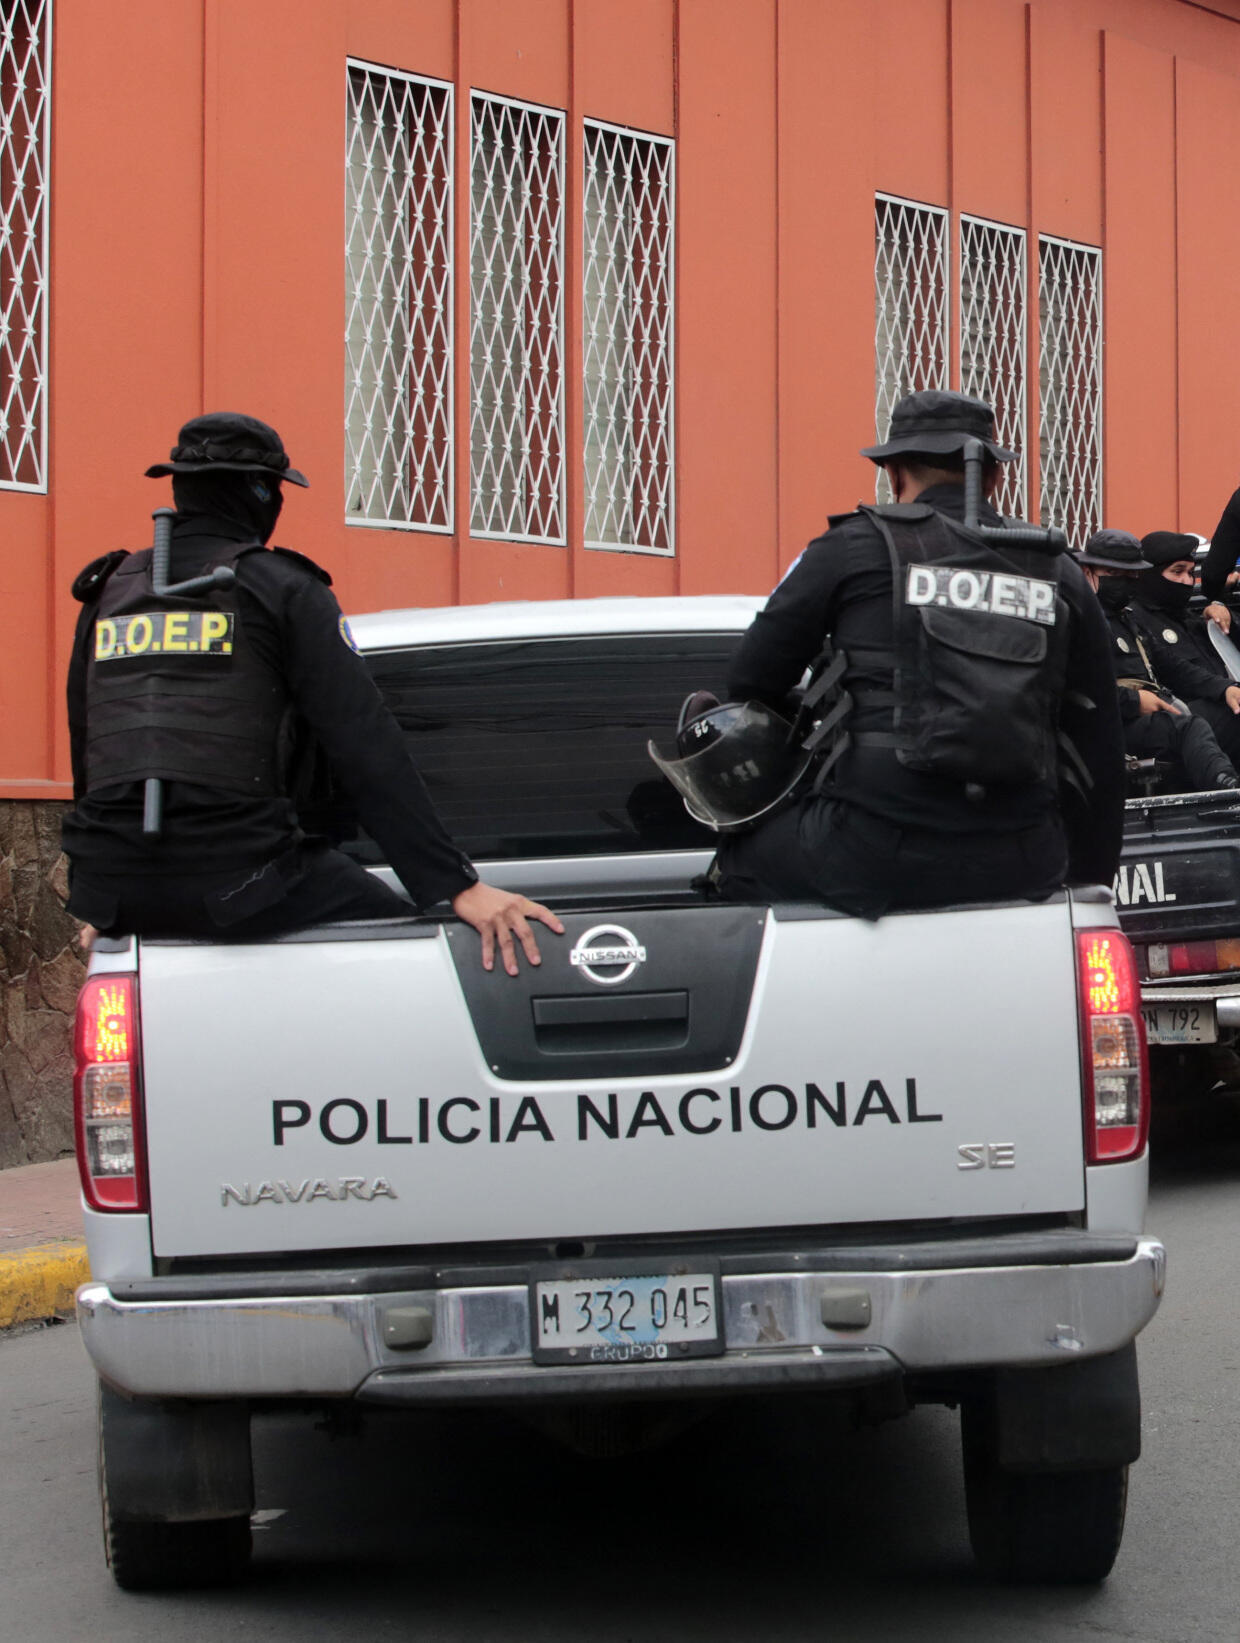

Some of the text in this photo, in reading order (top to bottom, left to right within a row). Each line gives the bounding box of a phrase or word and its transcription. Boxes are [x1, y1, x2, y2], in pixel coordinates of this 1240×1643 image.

[907, 566, 1056, 624] D.O.E.P.
[95, 612, 233, 660] D.O.E.P.
[579, 950, 639, 961] NISSAN
[1168, 1007, 1201, 1031] 792
[272, 1078, 943, 1146] POLICIA NACIONAL
[956, 1141, 1016, 1171] SE
[220, 1176, 399, 1207] NAVARA
[541, 1285, 711, 1335] M 332 045
